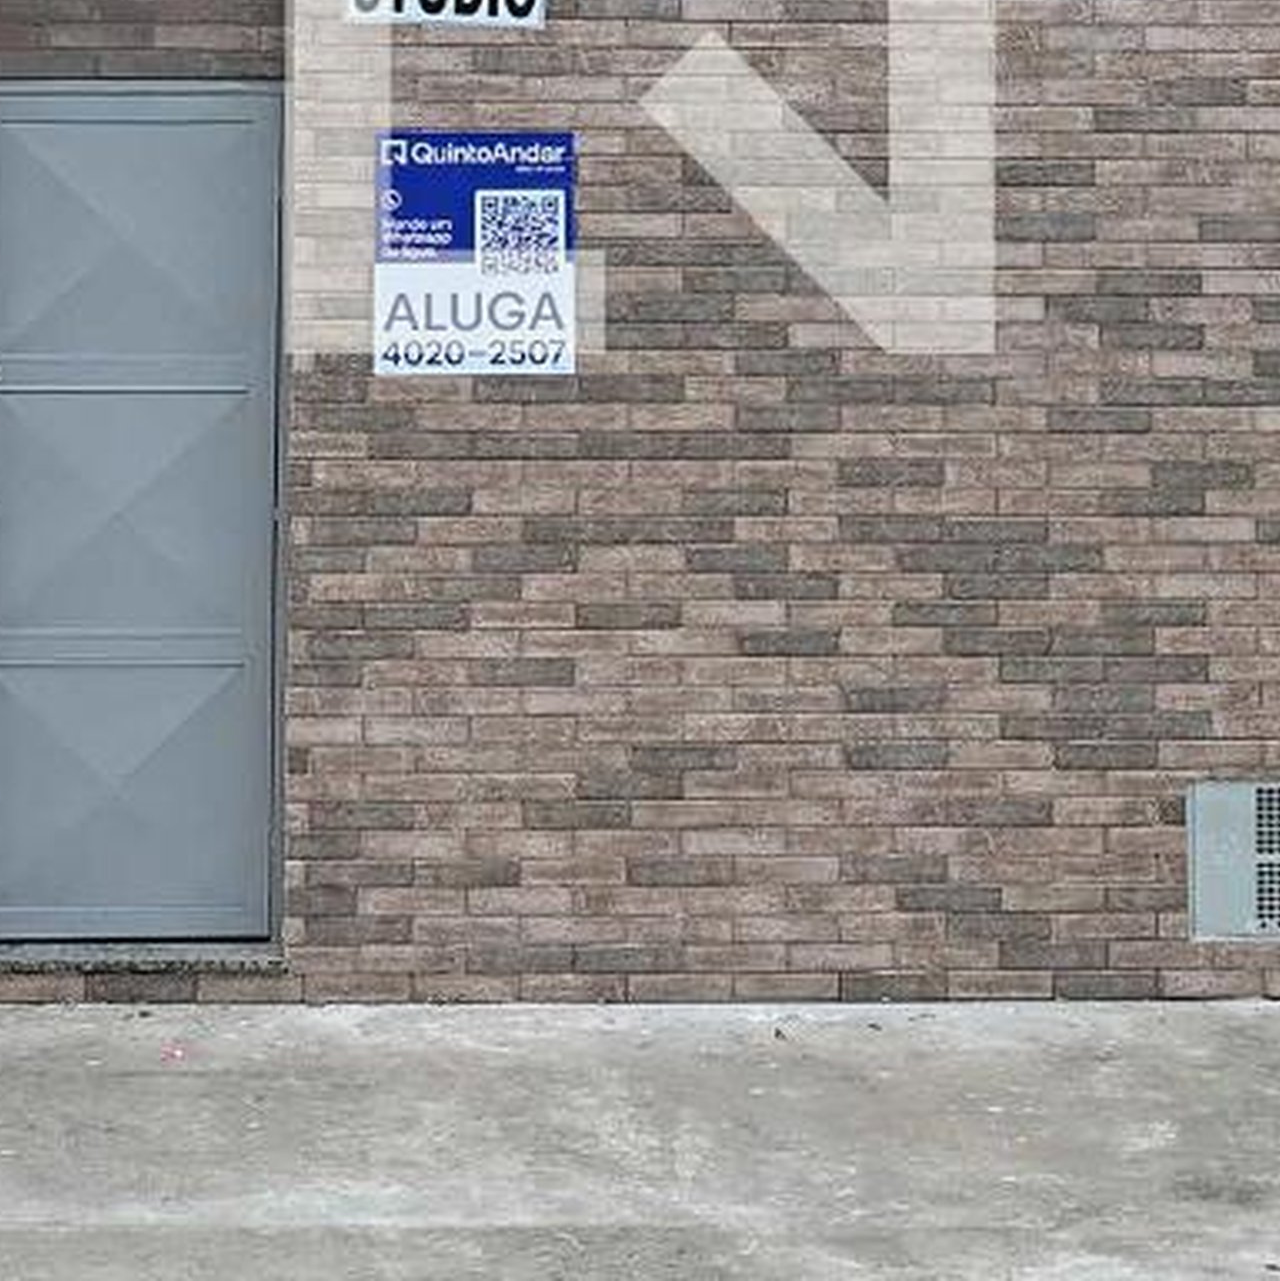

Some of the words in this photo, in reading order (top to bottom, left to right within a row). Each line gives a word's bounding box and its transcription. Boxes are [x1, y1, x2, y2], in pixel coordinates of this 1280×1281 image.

[411, 141, 566, 165] QuintoAndar
[384, 292, 564, 331] ALUGA
[382, 339, 566, 366] 4020-2507
